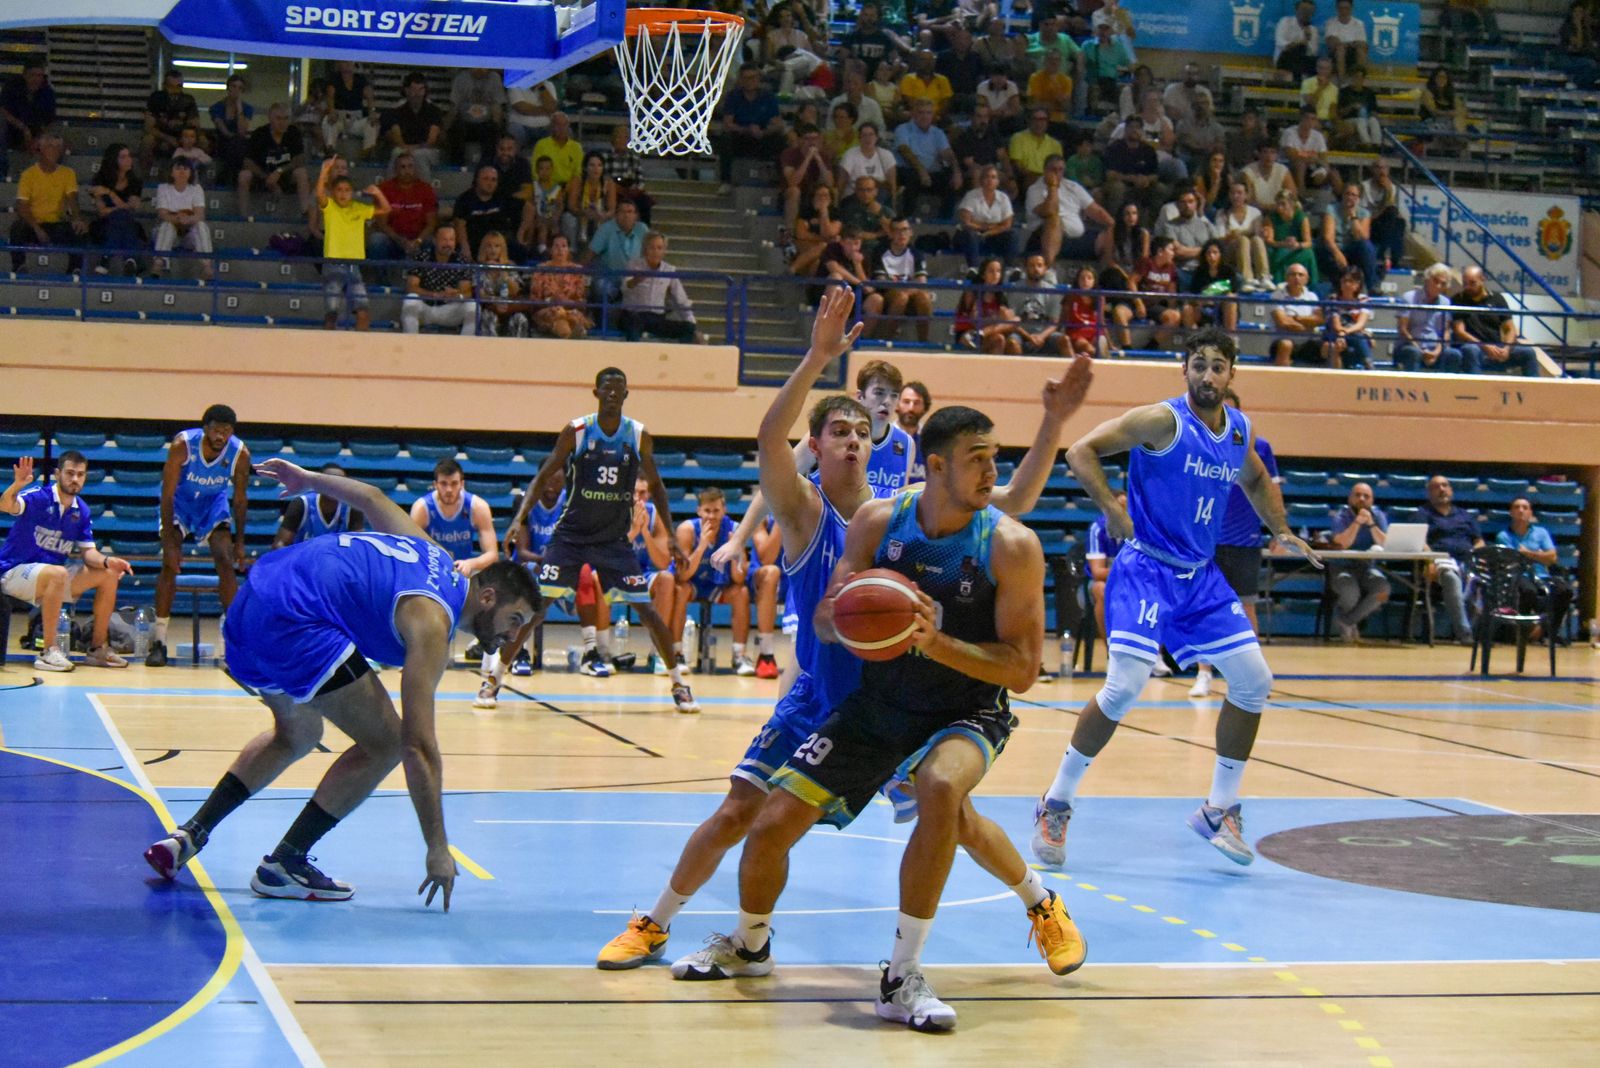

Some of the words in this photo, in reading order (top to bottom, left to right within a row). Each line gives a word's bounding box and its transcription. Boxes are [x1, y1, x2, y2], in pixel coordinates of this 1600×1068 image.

[1357, 386, 1429, 403] PRENSA
[1501, 391, 1525, 405] TV
[597, 466, 618, 485] 35
[1194, 496, 1215, 526] 14
[540, 564, 559, 580] 35
[1137, 599, 1159, 629] 14
[793, 733, 833, 765] 29
